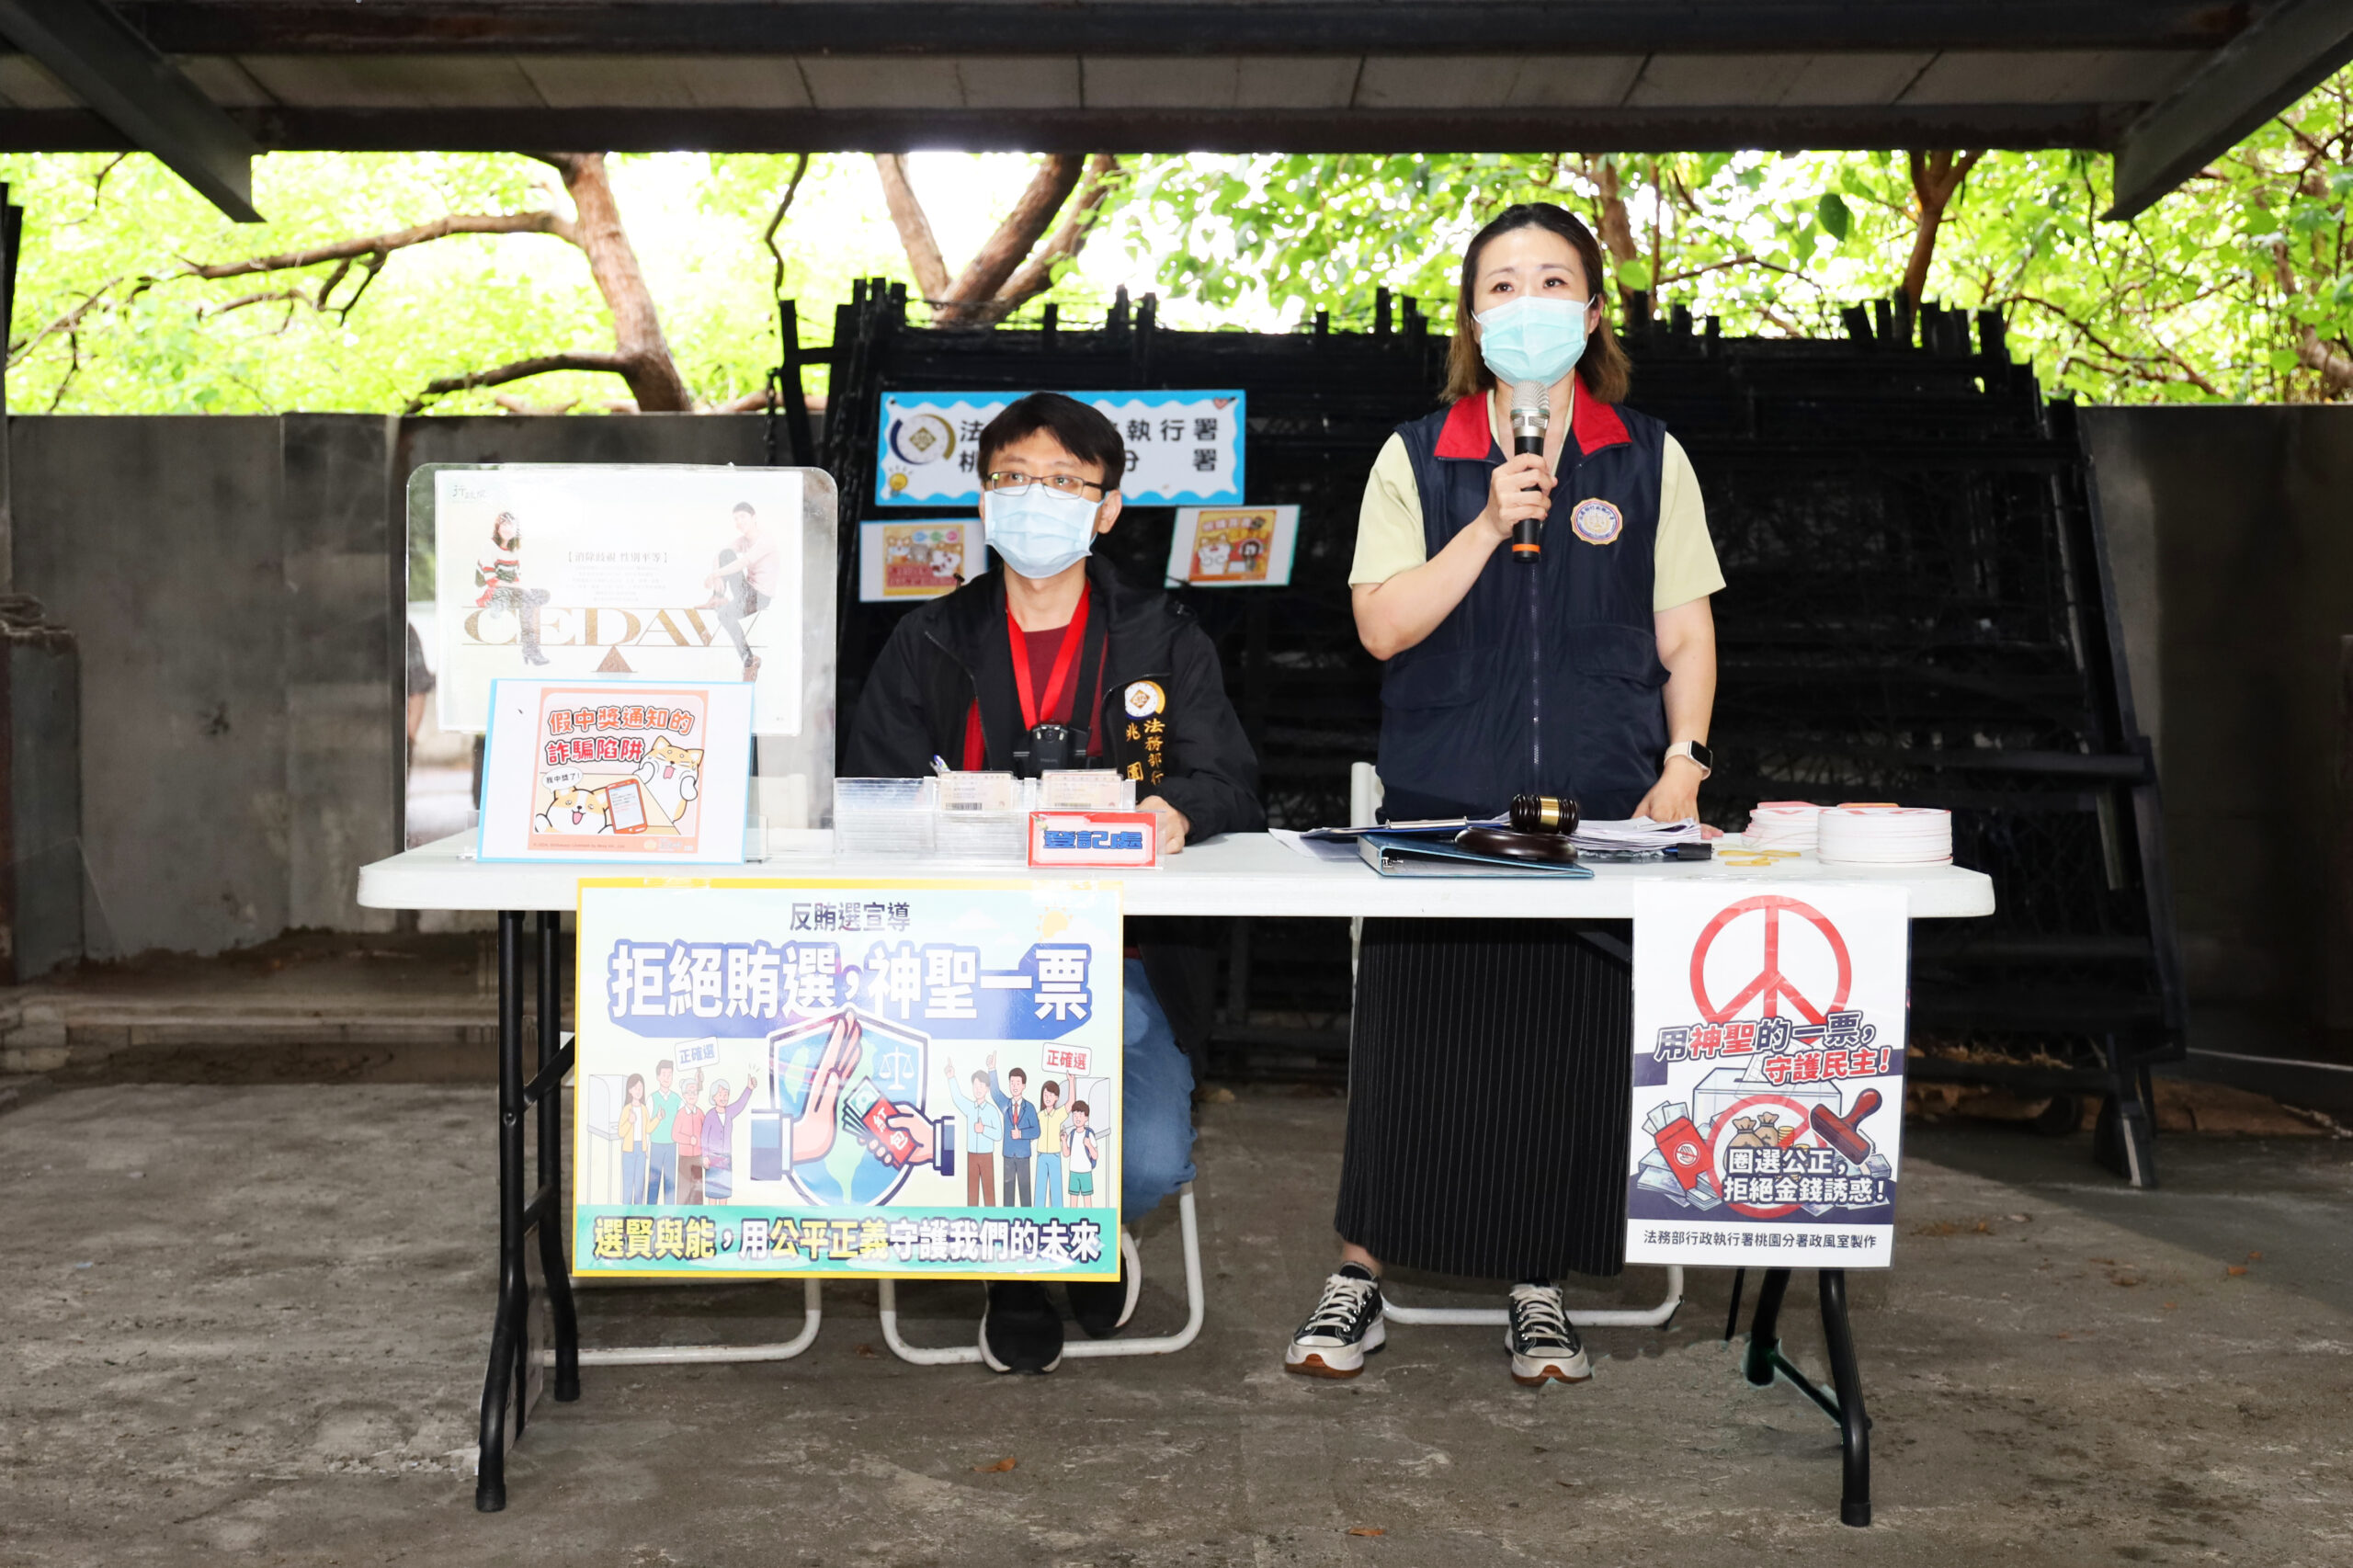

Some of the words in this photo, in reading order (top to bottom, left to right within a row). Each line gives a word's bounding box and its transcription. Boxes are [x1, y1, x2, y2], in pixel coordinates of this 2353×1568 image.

[464, 608, 762, 647] CEDAW
[549, 705, 695, 735] 假中獎通知的
[545, 736, 643, 766] 詐騙陷阱
[1042, 830, 1143, 850] 登記處
[790, 902, 911, 932] 反賄選宣導
[678, 1044, 716, 1066] 正確選
[1046, 1048, 1087, 1071] 正確選
[872, 1108, 909, 1151] 紅包
[1643, 1229, 1877, 1249] 法務部行政執行署桃園分署政風室製作
